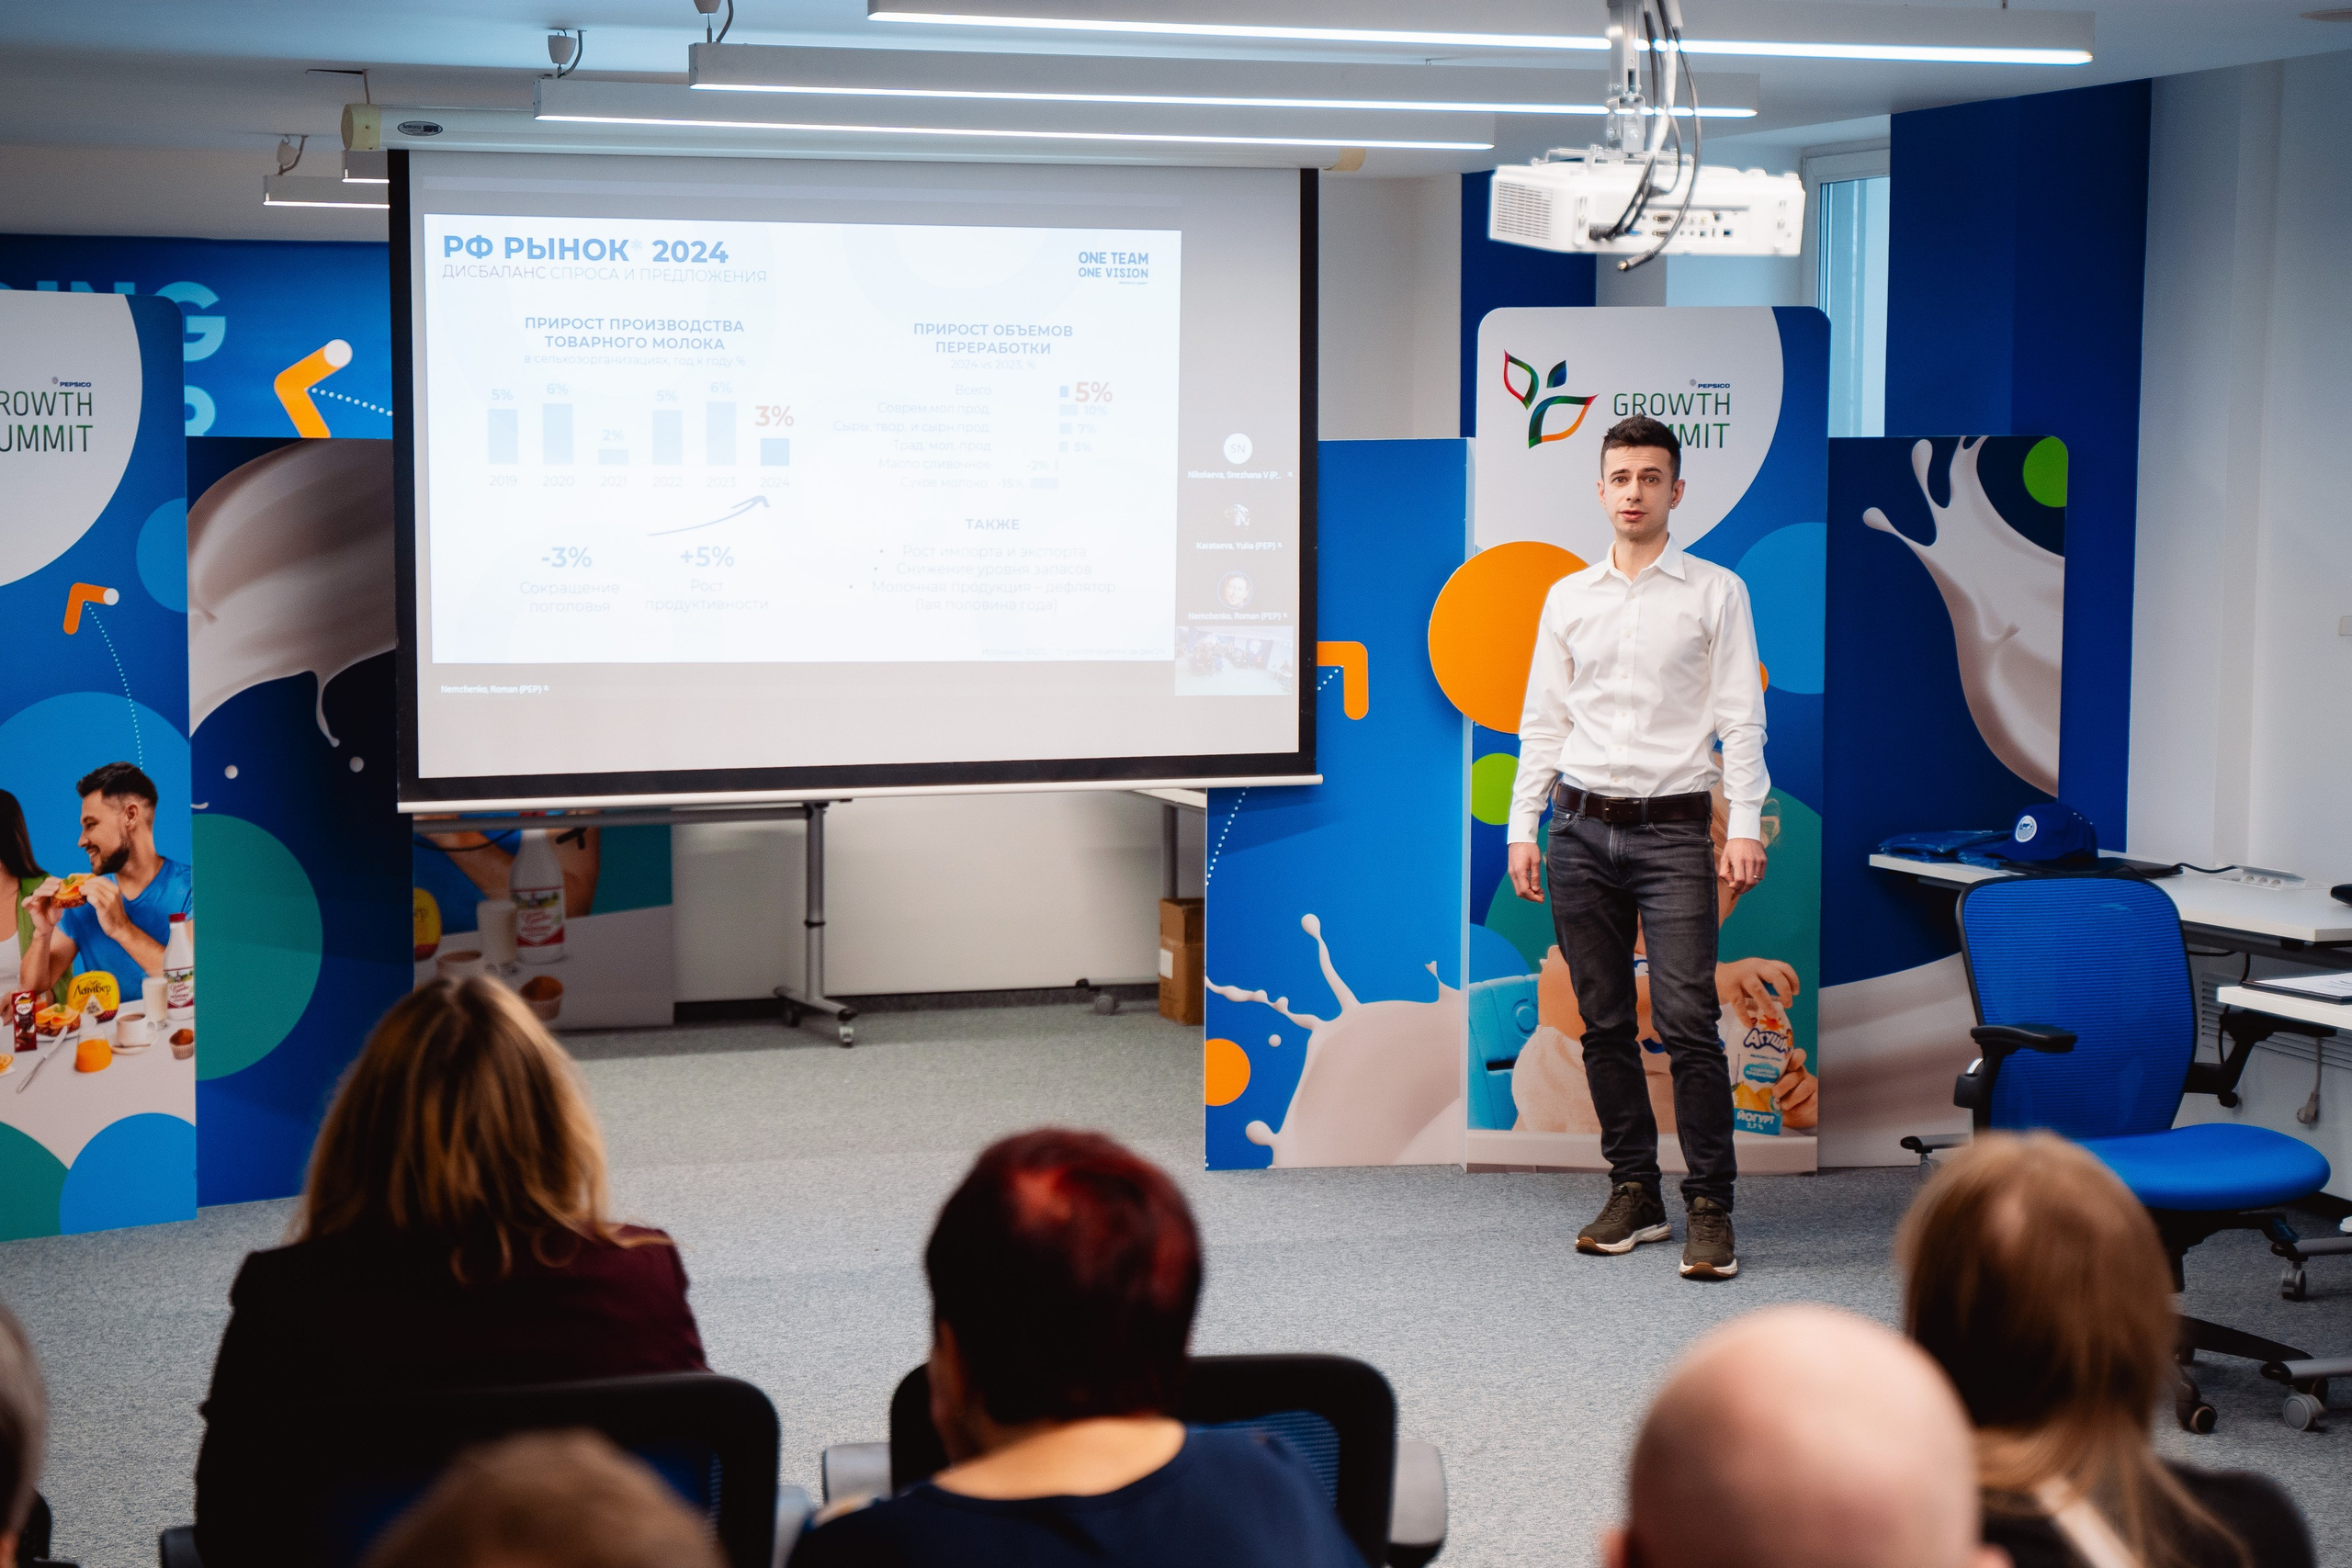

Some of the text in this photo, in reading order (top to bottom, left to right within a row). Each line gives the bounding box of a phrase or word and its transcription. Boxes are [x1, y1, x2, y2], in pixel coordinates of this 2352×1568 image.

[444, 235, 493, 259] РФ
[651, 240, 729, 264] 2024
[1079, 252, 1148, 265] ONE TEAM
[442, 265, 766, 283] ДИСБАЛАНС СПРОСА И ПРЕДЛОЖЕНИЯ
[1079, 267, 1148, 278] ONE VISION
[526, 317, 744, 333] ПРИРОСТ ПРОИЗВОДСТВА
[914, 323, 1072, 336] ПРИРОСТ ОБЪЕМОВ
[544, 336, 725, 349] ТОВАРНОГО МОЛОКА
[936, 342, 1050, 354] ПЕРЕРАБОТКИ
[546, 383, 569, 395] 6%
[710, 382, 732, 393] 6%
[956, 385, 991, 395] Всего
[1075, 382, 1113, 402] 5%
[492, 389, 514, 400] 5%
[656, 389, 678, 401] 5%
[0, 390, 93, 416] ROWTH
[1613, 392, 1731, 416] GROWTH
[755, 405, 794, 426] 3%
[1083, 405, 1108, 415] 10%
[1078, 423, 1096, 434] 7%
[0, 424, 94, 452] UMMIT
[603, 429, 624, 441] 2%
[1668, 423, 1731, 449] MIT
[1230, 443, 1246, 454] SN
[490, 475, 517, 486] 2019
[542, 476, 574, 487] 2020
[600, 476, 627, 487] 2021
[653, 477, 682, 487] 2022
[707, 477, 736, 487] 2023
[760, 477, 790, 488] 2024
[966, 519, 1019, 530] ТАКЖЕ
[541, 547, 592, 568] -3%
[681, 547, 734, 567] +5%
[903, 545, 936, 557] Рост
[941, 547, 1002, 559] импорта
[1020, 548, 1086, 558] экспорта
[897, 562, 1091, 577] Снижение уровня запасов
[520, 581, 619, 595] Сокращение
[691, 580, 724, 592] Рост
[872, 581, 946, 592] Молочная
[952, 583, 1030, 595] продукция
[1046, 581, 1115, 595] дефлятор
[530, 603, 610, 612] поголовья
[646, 601, 768, 613] продуктивности
[946, 601, 1016, 610] половина
[1021, 599, 1057, 612] года)
[490, 684, 518, 694] Roman
